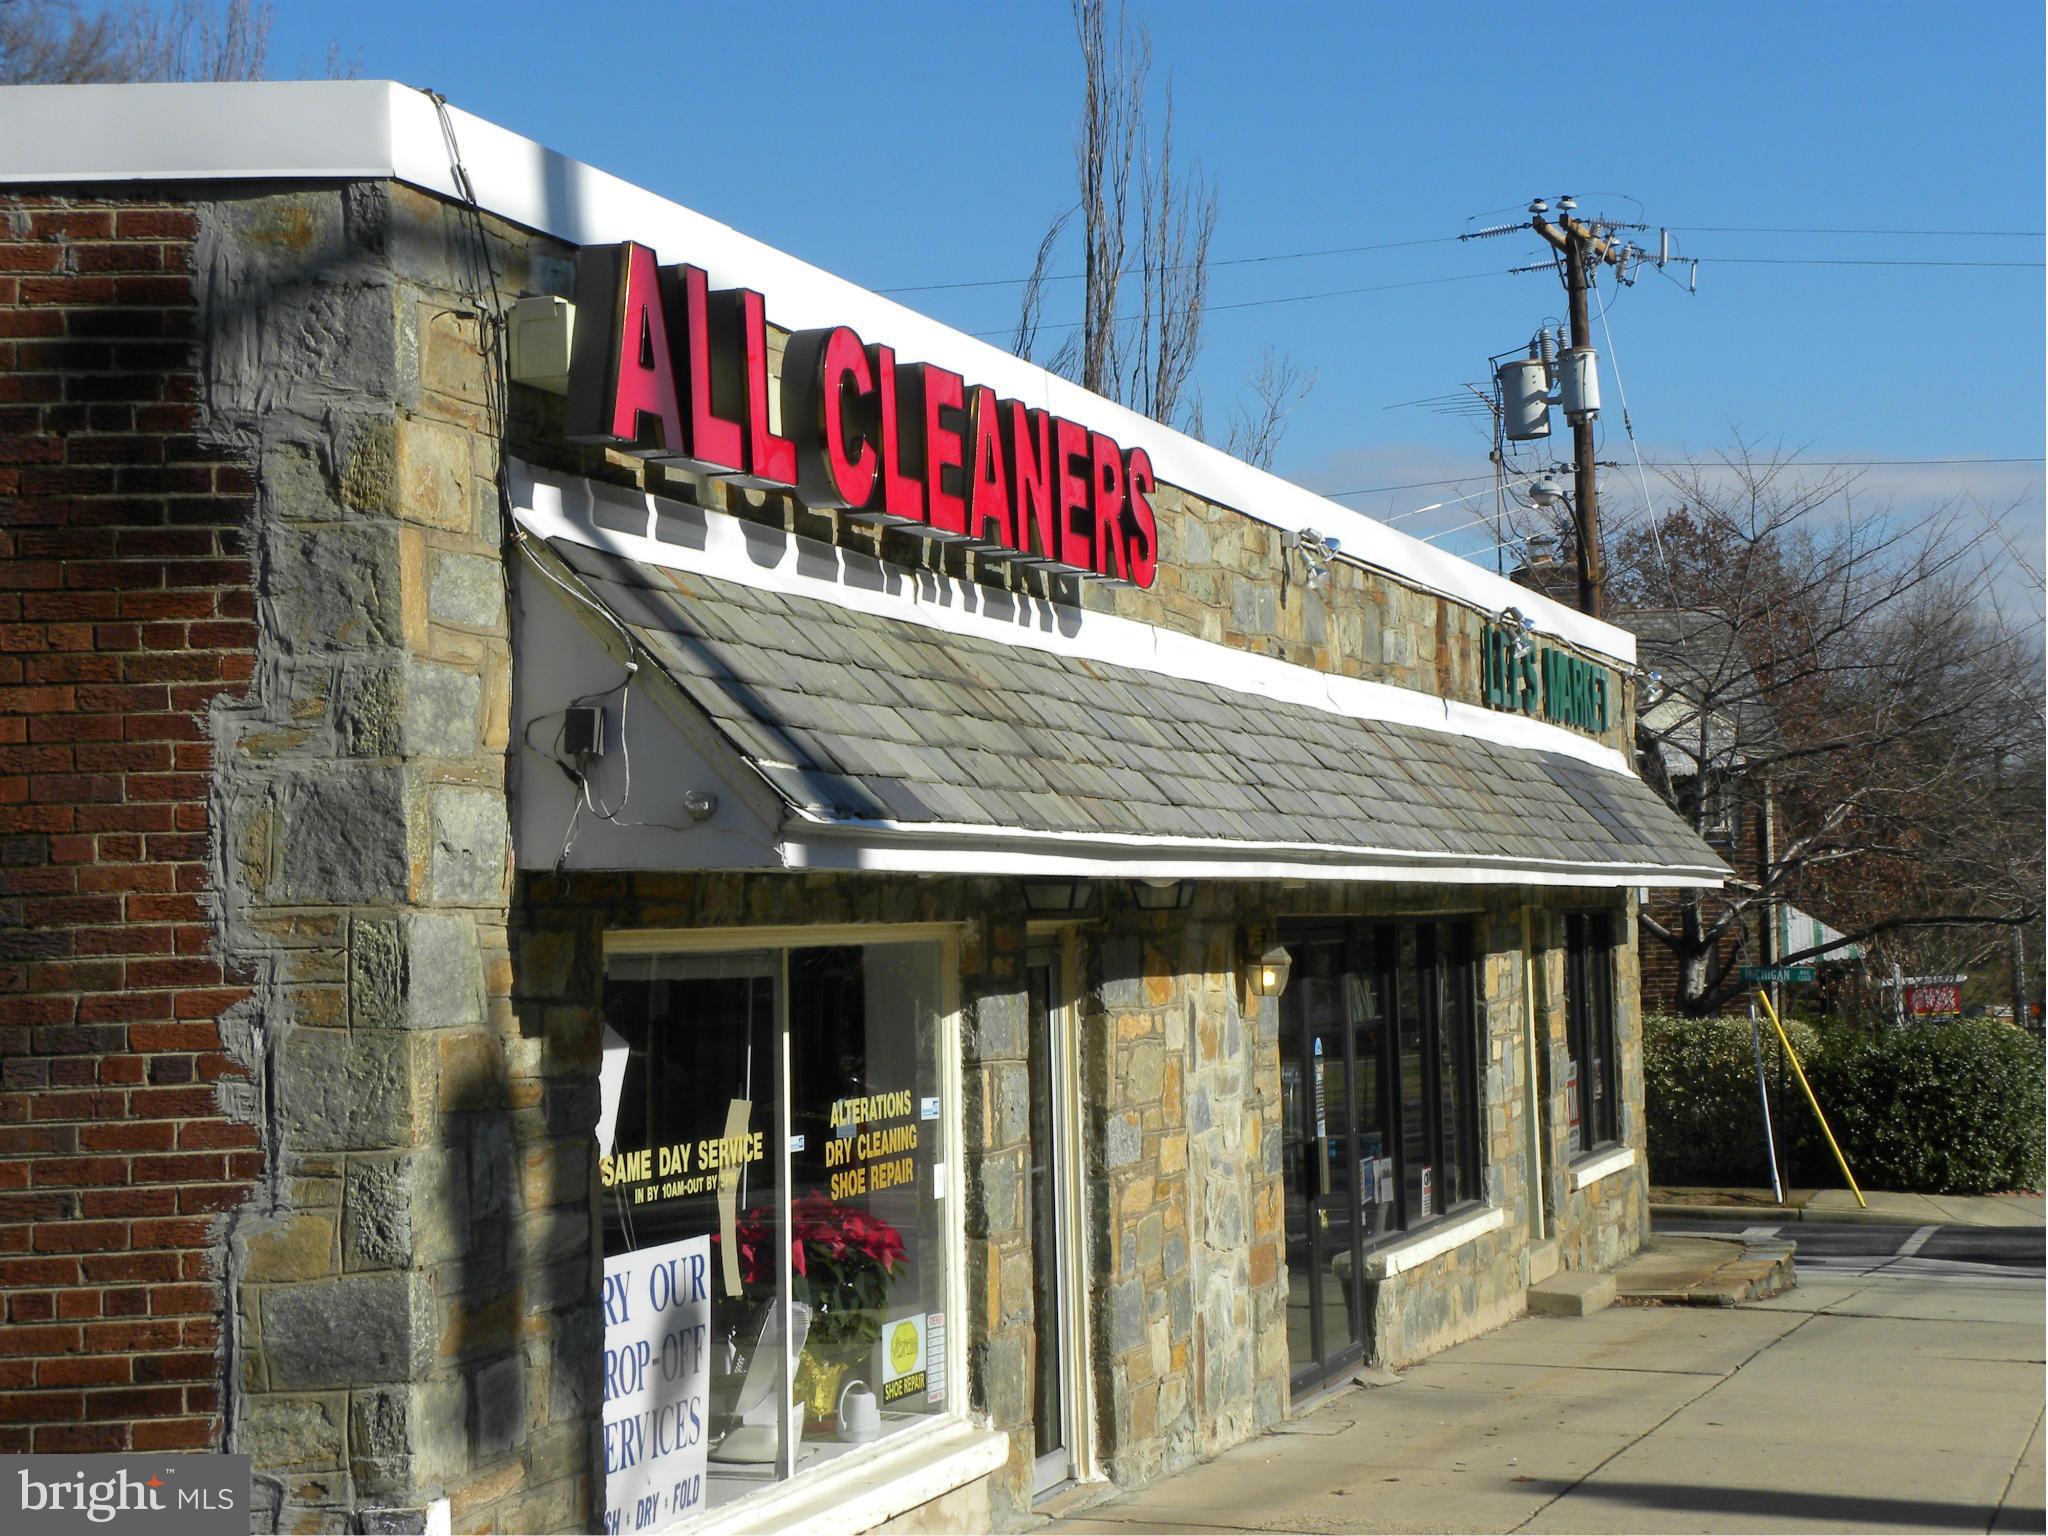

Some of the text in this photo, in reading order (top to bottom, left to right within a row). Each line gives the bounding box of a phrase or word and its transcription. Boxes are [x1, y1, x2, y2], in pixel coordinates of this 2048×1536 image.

[570, 240, 1157, 590] ALL CLEANERS
[1541, 647, 1608, 733] MARKET
[1745, 967, 1790, 981] MICHIGAN
[830, 1089, 912, 1128] ALTERATIONS
[600, 1132, 764, 1187] SAME DAY SERVICE
[825, 1123, 918, 1168] DRY CLEANING
[634, 1188, 645, 1204] IN
[647, 1185, 659, 1201] BY
[706, 1174, 718, 1190] BY
[831, 1157, 914, 1201] SHOE REPAIR
[649, 1254, 707, 1312] OUR
[603, 1324, 706, 1402] ROP-OFF
[884, 1372, 926, 1401] SHOE REPAIR
[603, 1395, 701, 1475] ERVICES
[635, 1491, 660, 1531] DRY
[672, 1473, 700, 1515] FOLD
